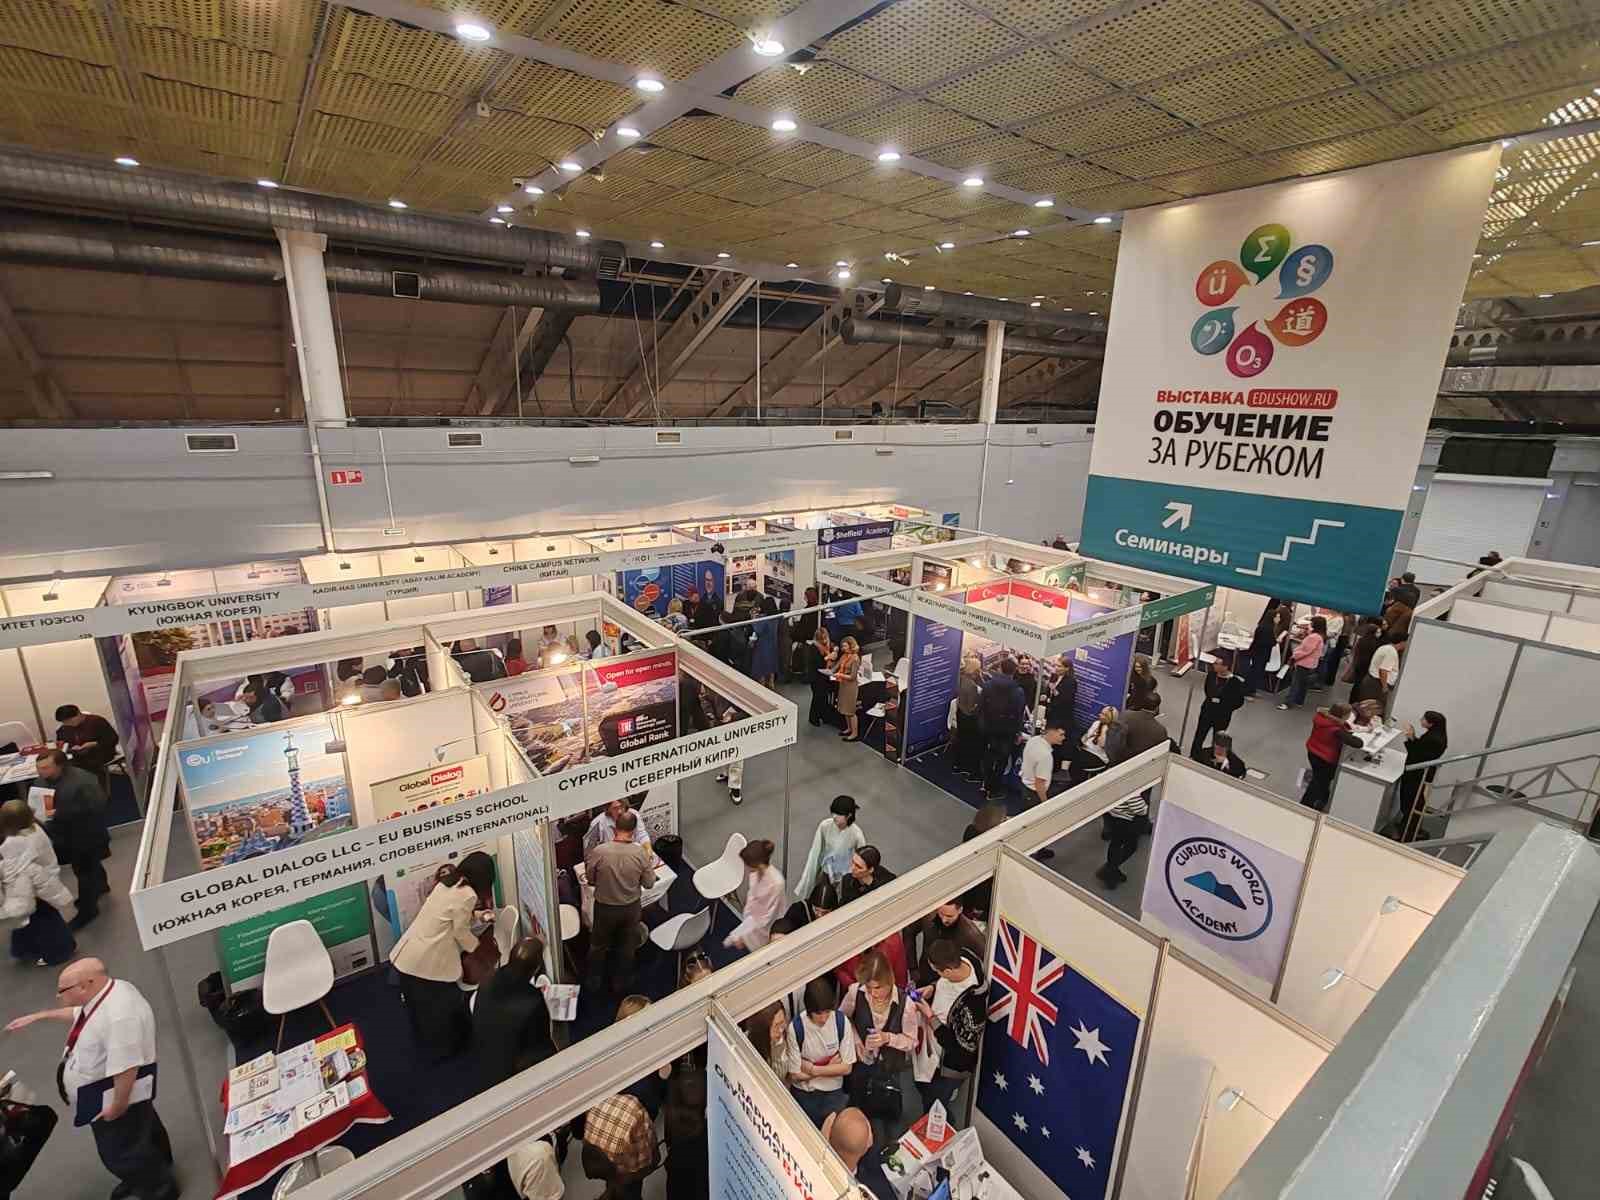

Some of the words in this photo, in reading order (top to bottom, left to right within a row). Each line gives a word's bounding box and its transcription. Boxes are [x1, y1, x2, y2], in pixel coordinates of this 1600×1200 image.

[1282, 305, 1316, 337] 道
[1156, 389, 1244, 406] ВЫСТАВКА
[1251, 390, 1333, 408] EDUSHOW.RU
[1153, 409, 1334, 442] ОБУЧЕНИЕ
[1148, 436, 1177, 467] ЗА
[1184, 437, 1326, 480] РУБЕЖОМ
[1114, 527, 1230, 567] Семинары
[503, 564, 529, 573] CHINA
[529, 559, 562, 570] CAMPUS
[563, 556, 600, 566] NETWORK
[127, 599, 206, 617] KYUNGBOK
[208, 591, 281, 607] UNIVERSITY
[156, 610, 213, 627] (ЮЖНАЯ
[216, 605, 262, 619] КОРЕЯ)
[0, 619, 35, 631] ИТЕТ
[40, 614, 85, 627] ЮЭСЮ
[605, 670, 625, 681] Open
[635, 664, 652, 674] open
[558, 765, 618, 791] CYPRUS
[621, 735, 721, 773] INTERNATIONAL
[724, 715, 788, 742] UNIVERSITY
[619, 737, 647, 750] Global
[648, 730, 669, 742] Rank
[399, 777, 431, 792] Global
[432, 769, 463, 783] Dialog
[624, 757, 702, 792] (СЕВЕРНЫЙ
[705, 746, 740, 765] КИПР)
[180, 873, 259, 904] GLOBAL
[262, 851, 328, 880] DIALOG
[331, 839, 363, 861] LLC
[378, 831, 399, 846] EU
[402, 810, 473, 838] BUSINESS
[476, 794, 529, 817] SCHOOL
[151, 902, 228, 936] (ЮЖНАЯ
[231, 884, 290, 909] КОРЕЯ,
[293, 856, 376, 891] ГЕРМАНИЯ,
[379, 833, 454, 864] СЛОВЕНИЯ,
[456, 805, 550, 839] INTERNATIONAL)
[1175, 843, 1227, 867] CURIOUS
[1230, 855, 1265, 907] WORLD
[1181, 897, 1240, 934] ACADEMY
